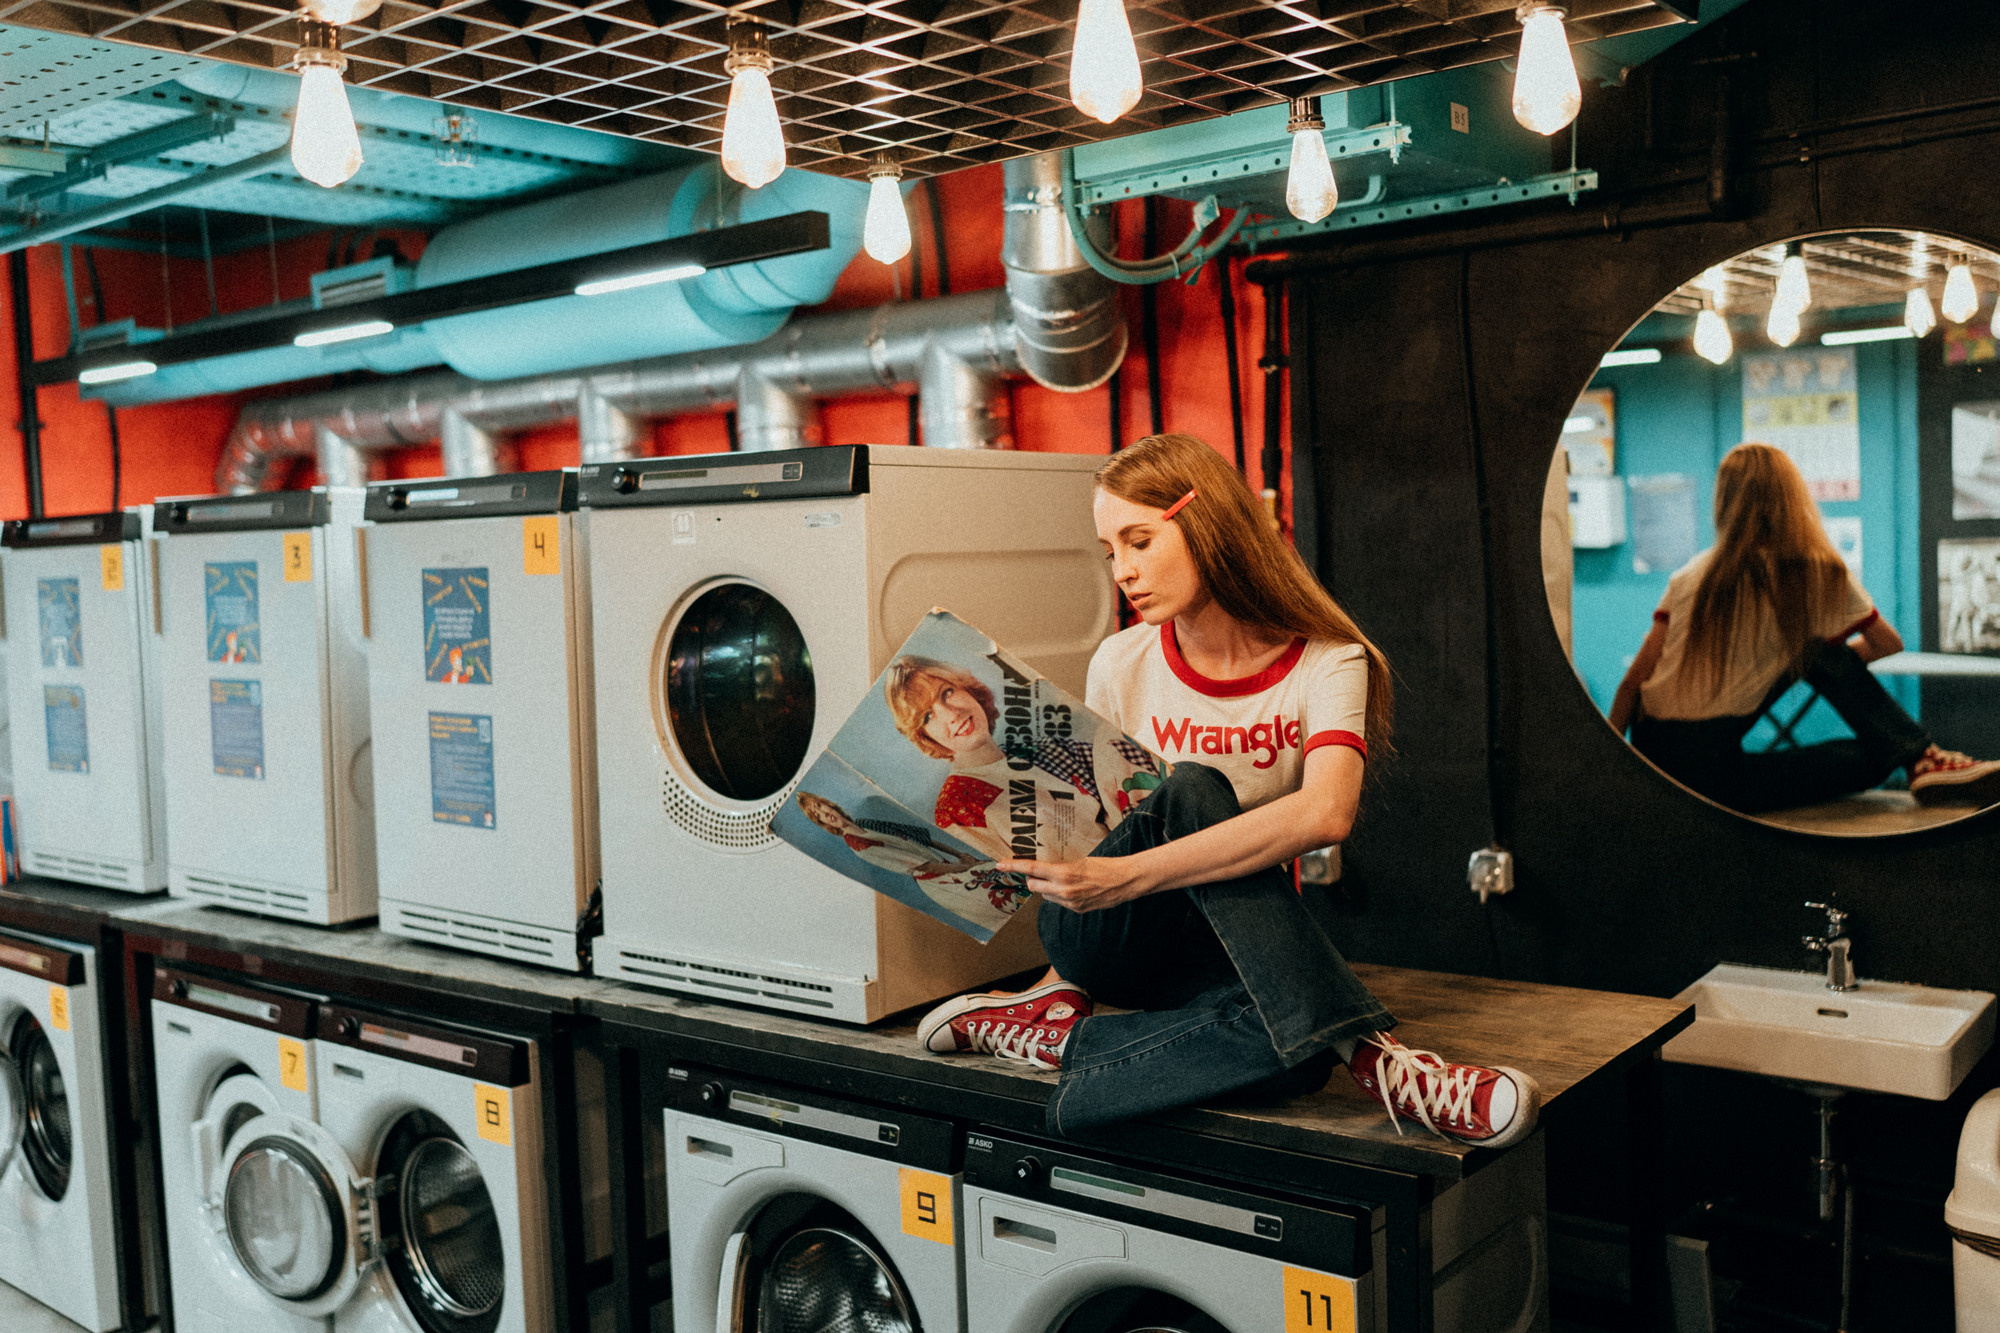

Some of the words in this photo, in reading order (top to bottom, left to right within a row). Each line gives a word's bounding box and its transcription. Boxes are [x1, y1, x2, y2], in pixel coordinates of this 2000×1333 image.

[293, 545, 302, 567] 3
[534, 532, 546, 558] 4
[1043, 704, 1072, 738] 83
[1048, 789, 1075, 801] 1
[287, 1051, 297, 1074] 7
[486, 1099, 500, 1126] 8
[975, 1139, 993, 1149] ASKO
[917, 1191, 936, 1225] 9
[1300, 1289, 1332, 1331] 11
